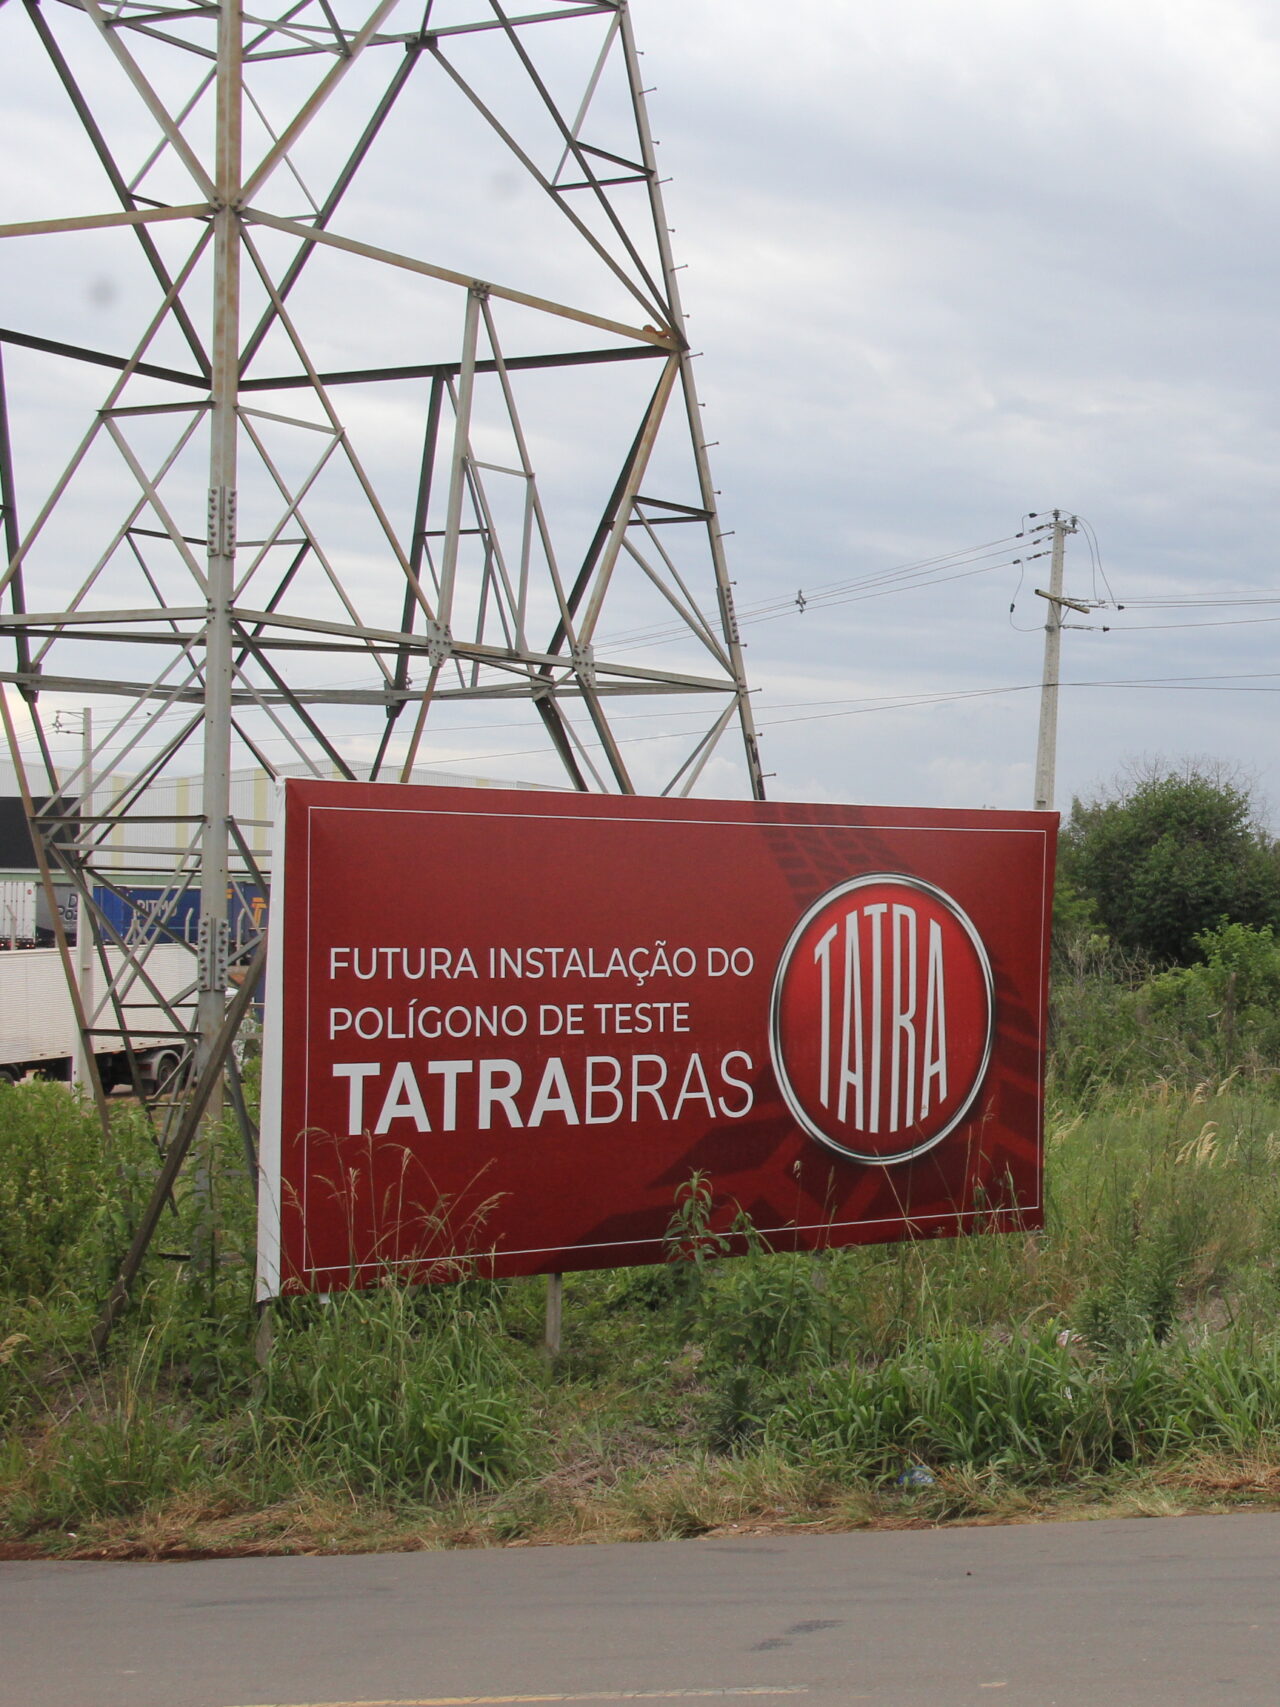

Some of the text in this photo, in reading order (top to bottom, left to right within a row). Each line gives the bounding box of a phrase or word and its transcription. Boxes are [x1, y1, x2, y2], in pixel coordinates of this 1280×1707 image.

[330, 939, 754, 987] FUTURA INSTALAÇÃO DO
[330, 998, 690, 1040] POLÍGONO DE TESTE
[814, 902, 948, 1134] TATRA
[332, 1050, 755, 1136] TATRABRAS
